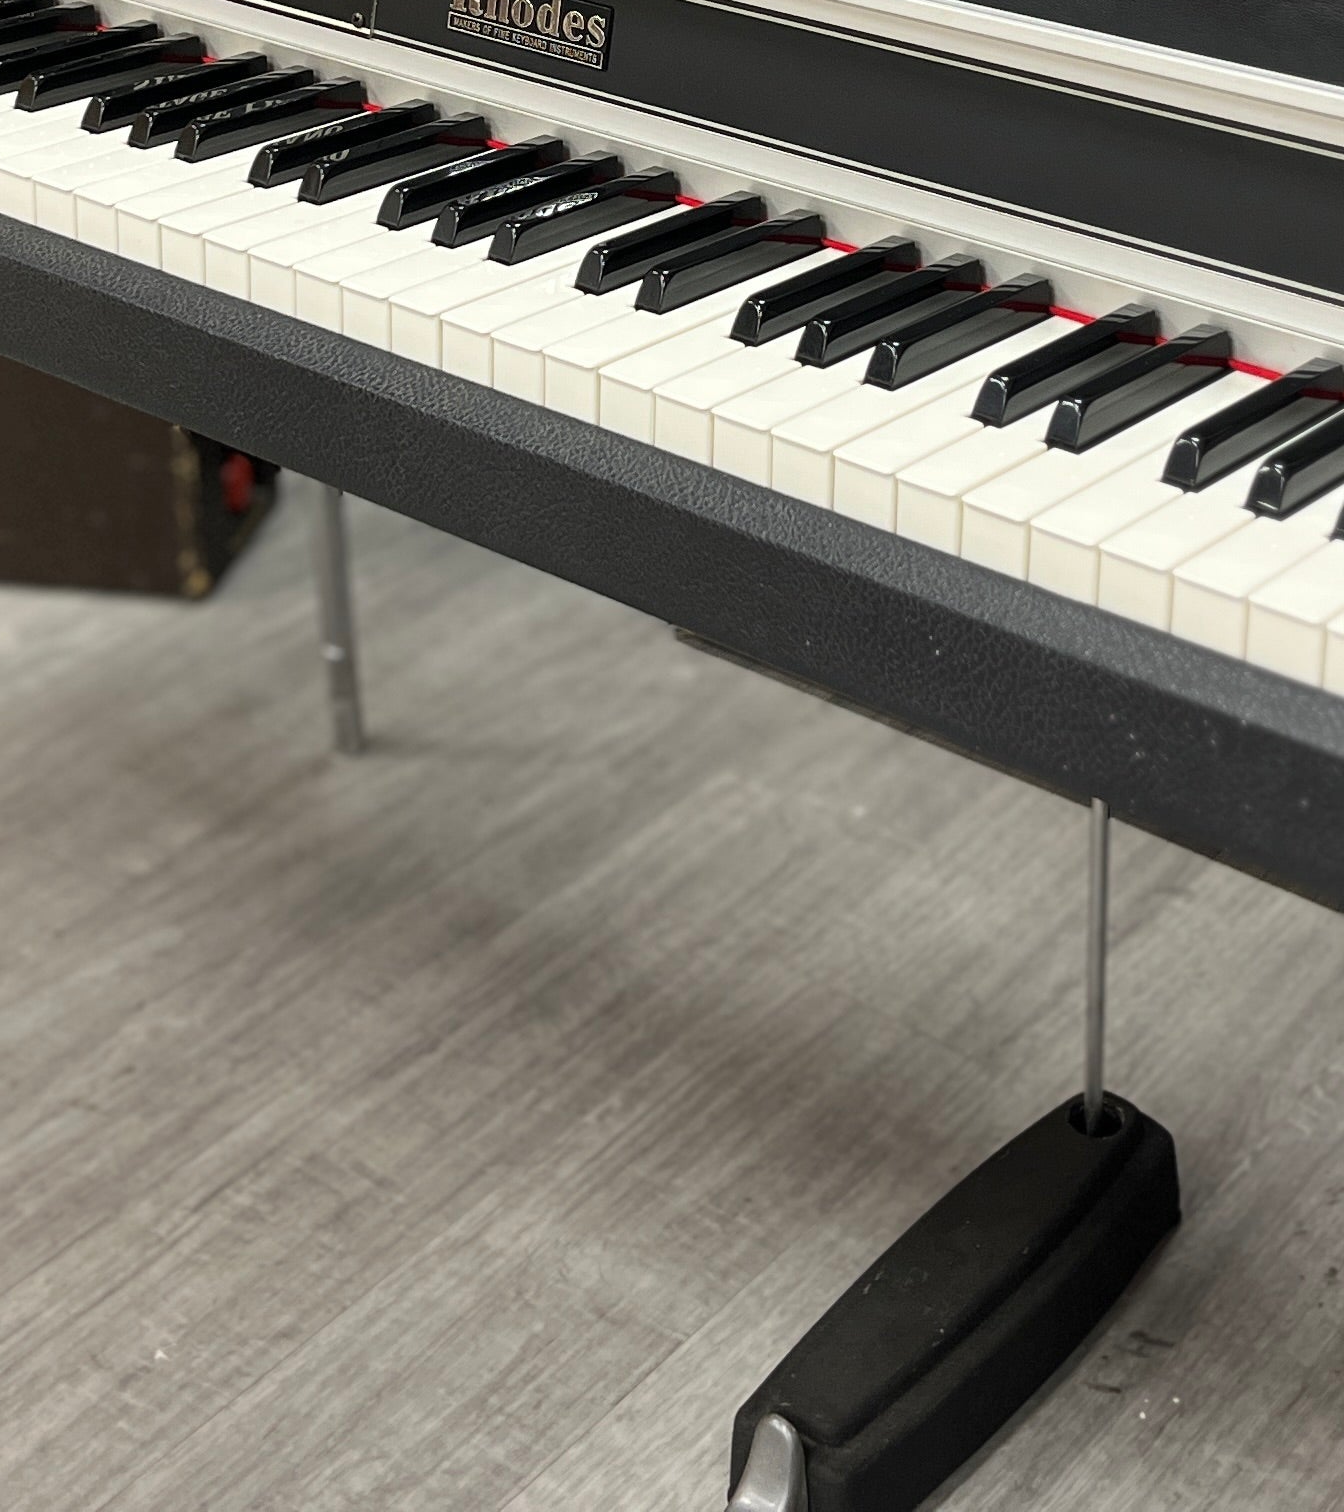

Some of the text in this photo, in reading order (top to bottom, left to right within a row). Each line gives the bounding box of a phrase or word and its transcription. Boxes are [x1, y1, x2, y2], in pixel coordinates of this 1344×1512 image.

[454, 16, 481, 33] MAKERS
[483, 24, 492, 35] OF
[512, 32, 547, 50] KEYBOARD
[549, 42, 597, 63] INSTRUMENTS
